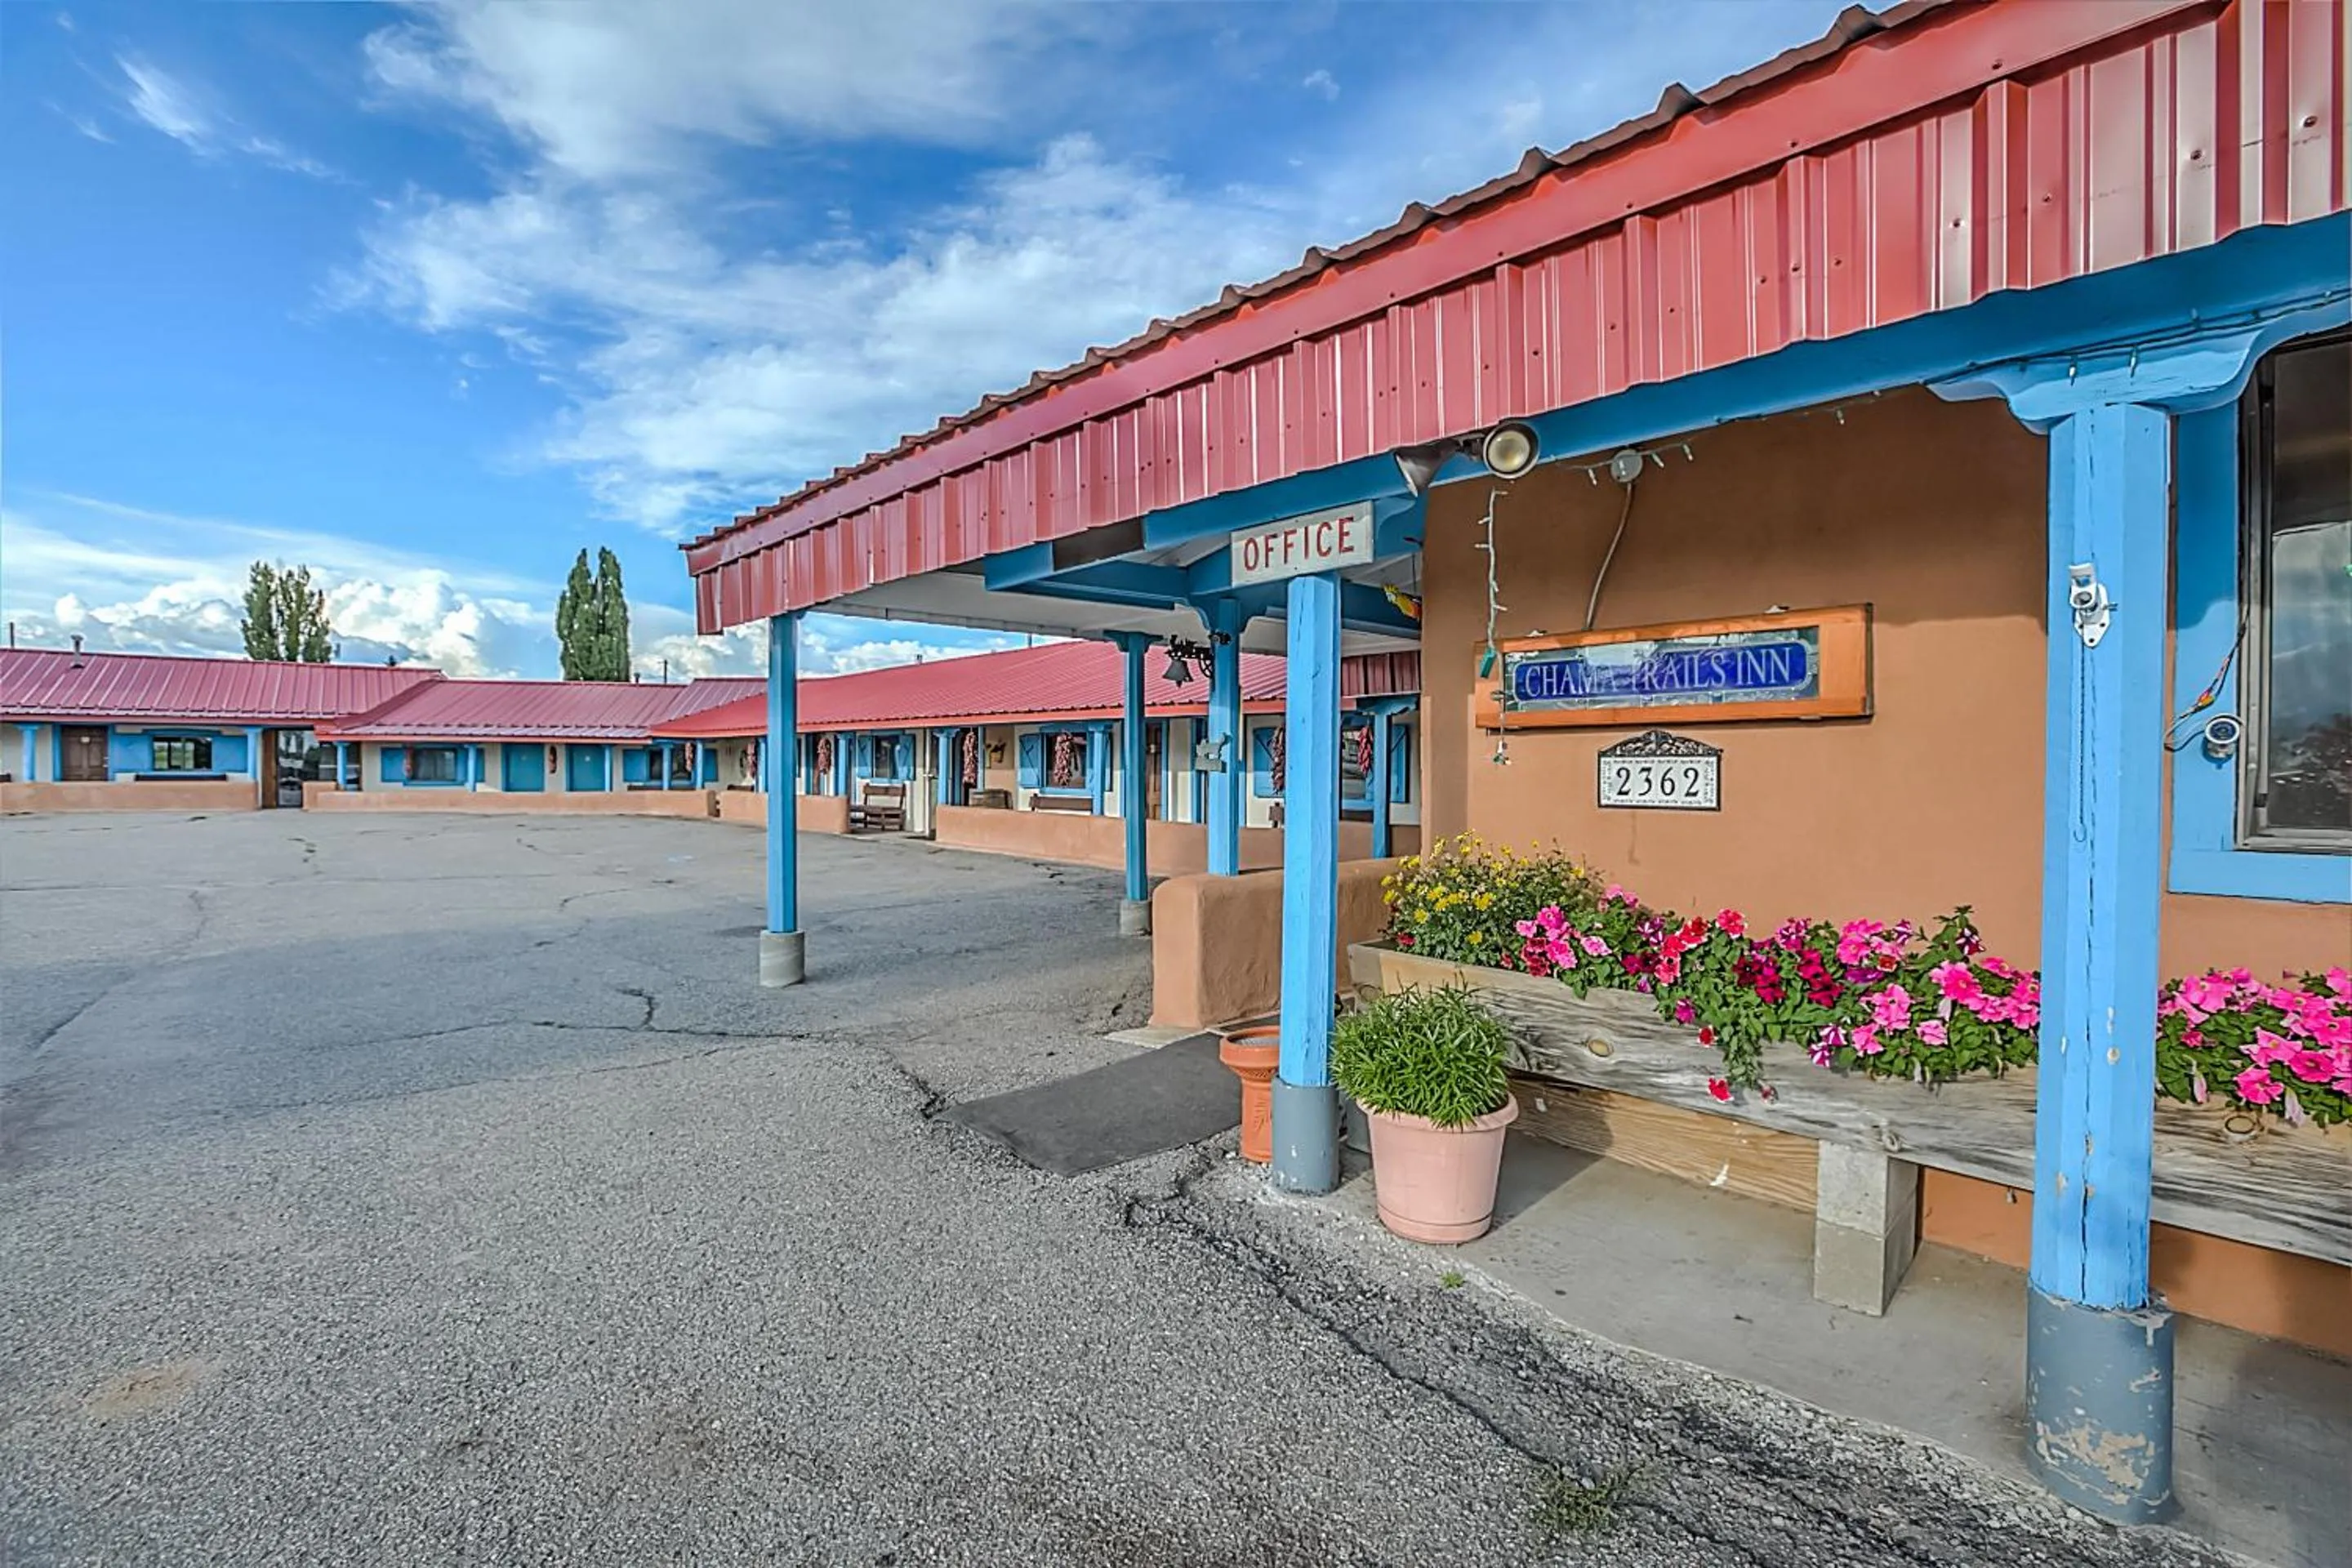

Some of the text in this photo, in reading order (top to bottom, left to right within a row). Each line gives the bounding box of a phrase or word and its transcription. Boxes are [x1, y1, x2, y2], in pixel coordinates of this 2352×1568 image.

[1244, 516, 1354, 571] OFFICE
[1736, 647, 1792, 685] INN
[1616, 766, 1699, 797] 2362
